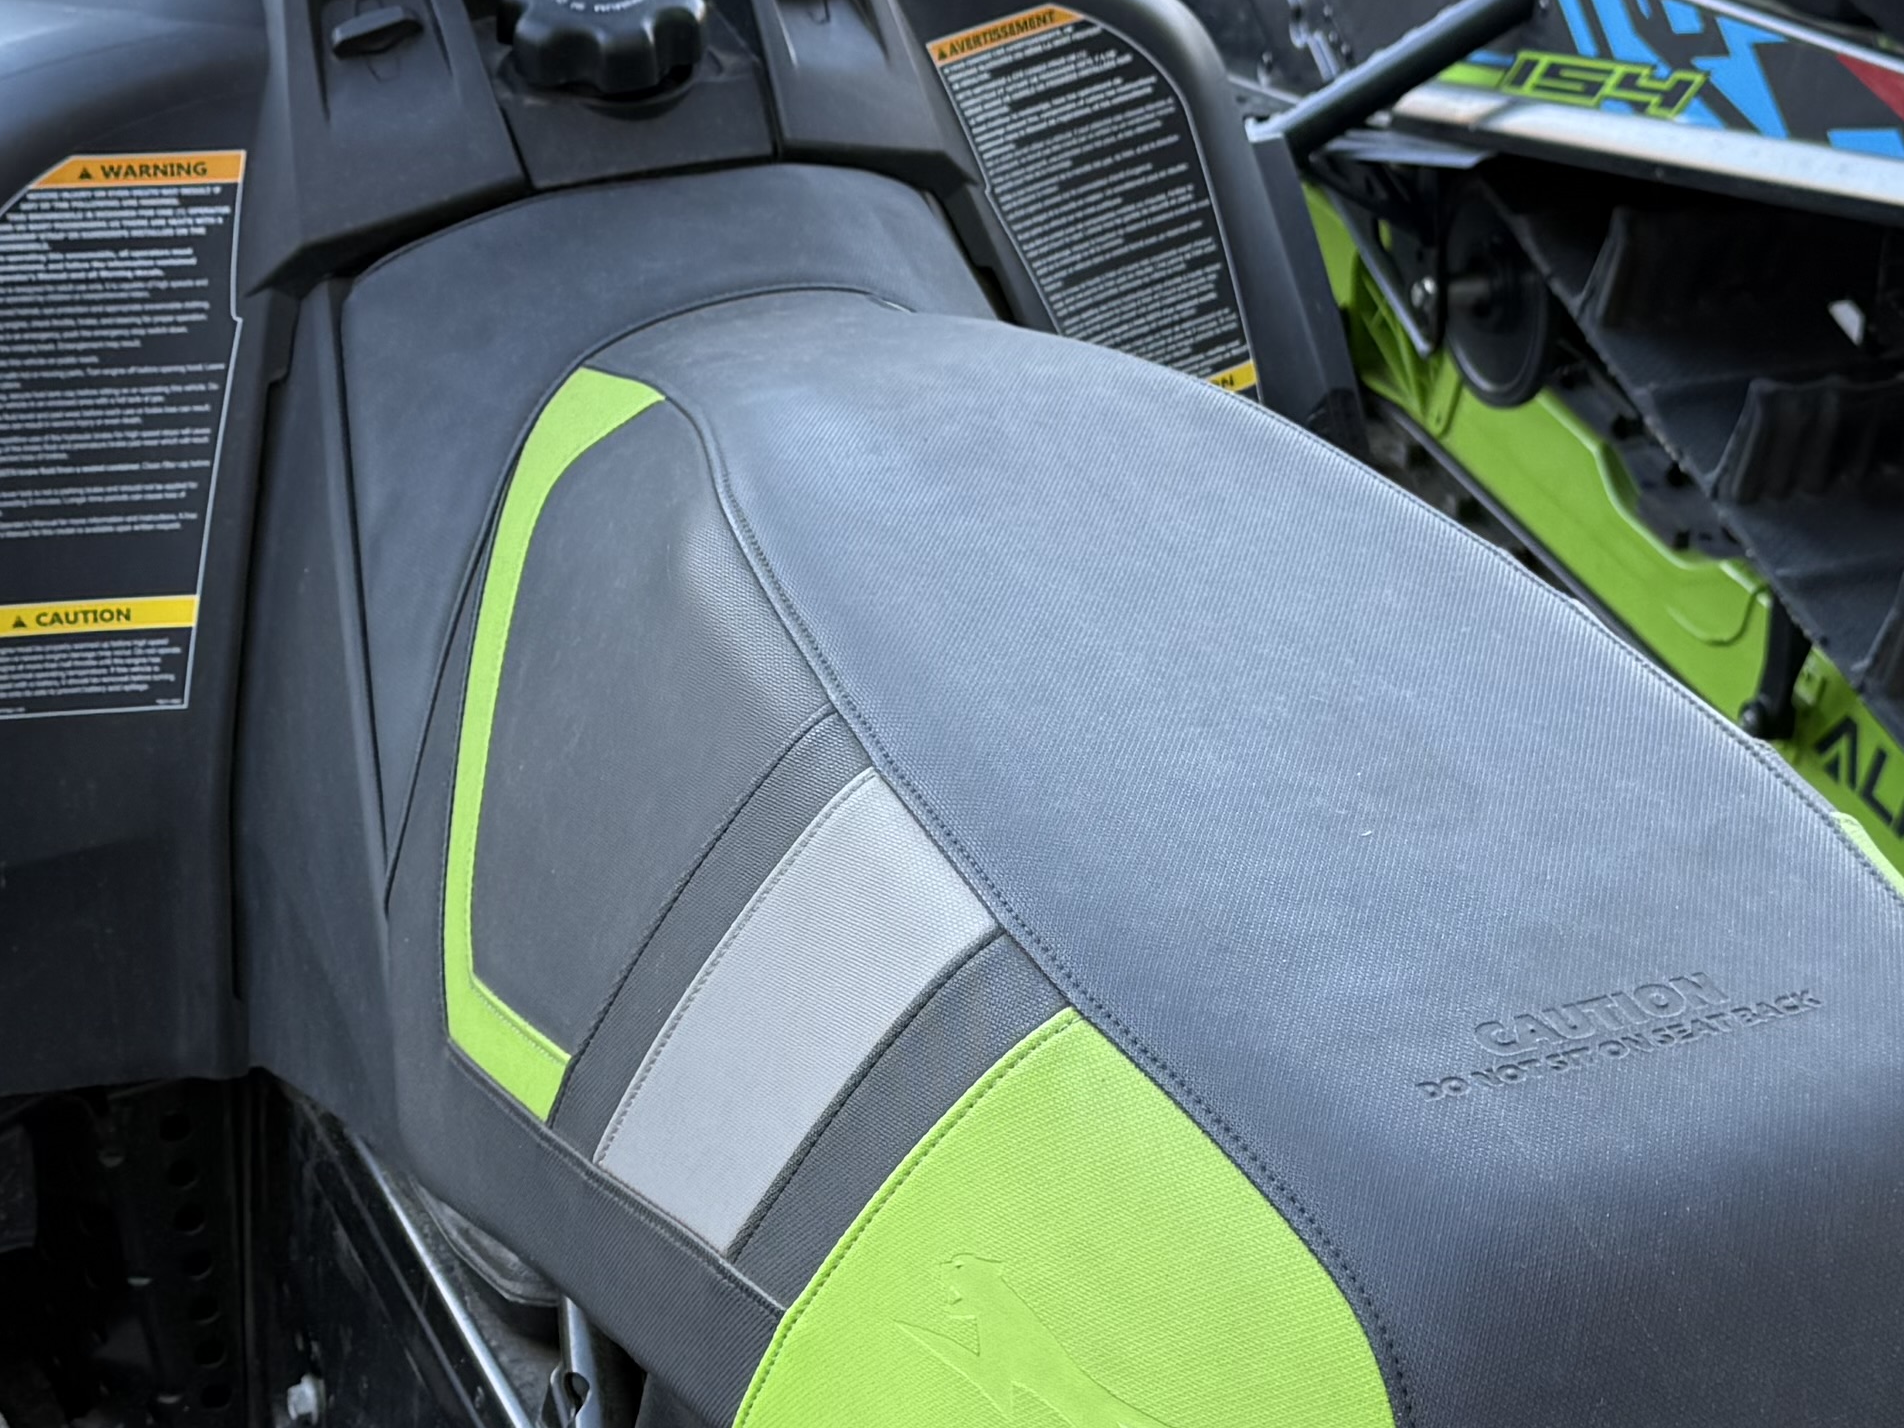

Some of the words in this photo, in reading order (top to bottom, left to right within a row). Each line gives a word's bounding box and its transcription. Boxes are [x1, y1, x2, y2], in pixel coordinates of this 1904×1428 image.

[1499, 50, 1710, 119] 154
[100, 160, 208, 180] WARNING
[36, 607, 131, 628] CAUTION
[1416, 1075, 1471, 1103] DO
[1471, 1057, 1540, 1088] NOT
[1545, 1045, 1594, 1072] SIT
[1598, 1032, 1654, 1061] ON
[1653, 1012, 1733, 1047] SEAT
[1731, 988, 1823, 1028] BACK
[1472, 971, 1731, 1056] CAUTION
